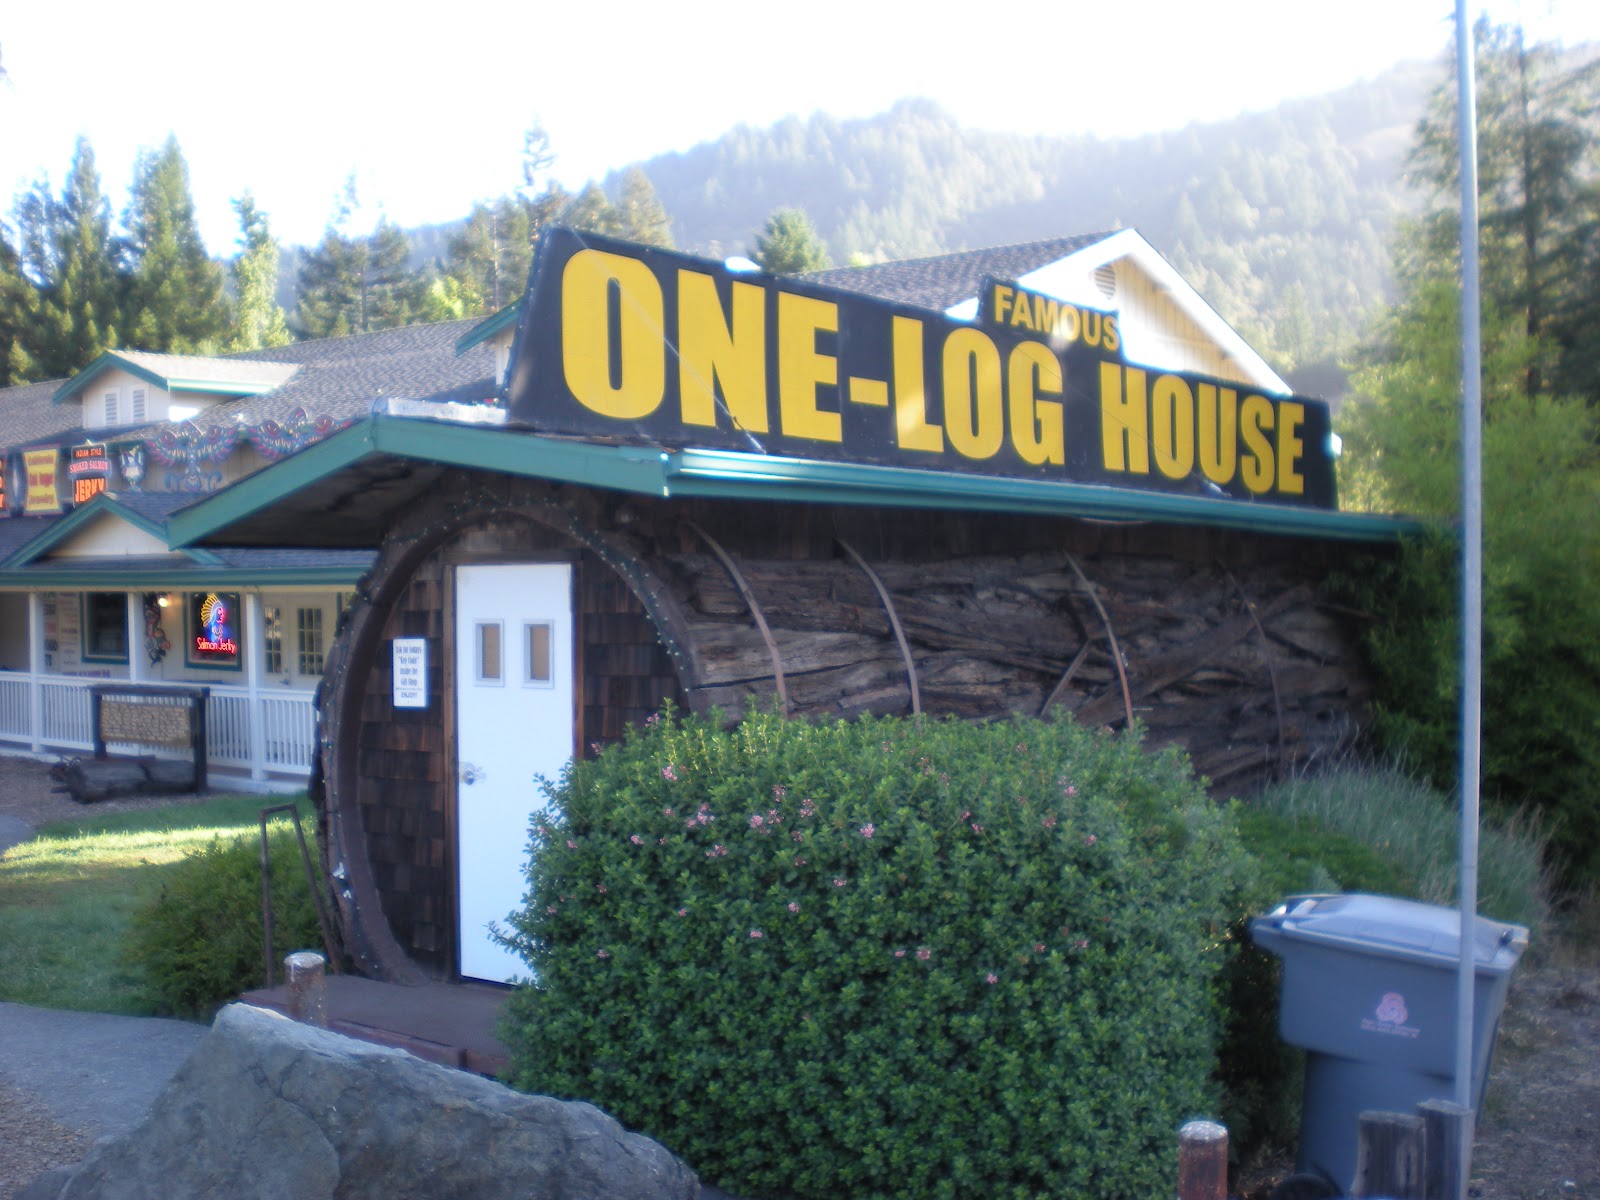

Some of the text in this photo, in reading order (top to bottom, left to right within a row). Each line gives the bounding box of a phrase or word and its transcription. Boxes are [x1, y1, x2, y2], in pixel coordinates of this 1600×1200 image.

[994, 284, 1120, 352] FAMOUS
[561, 247, 1306, 496] ONE-LOG HOUSE
[69, 460, 108, 473] SMOKED SALMON
[75, 478, 104, 503] JERKY
[197, 637, 236, 654] Salmon Jerky
